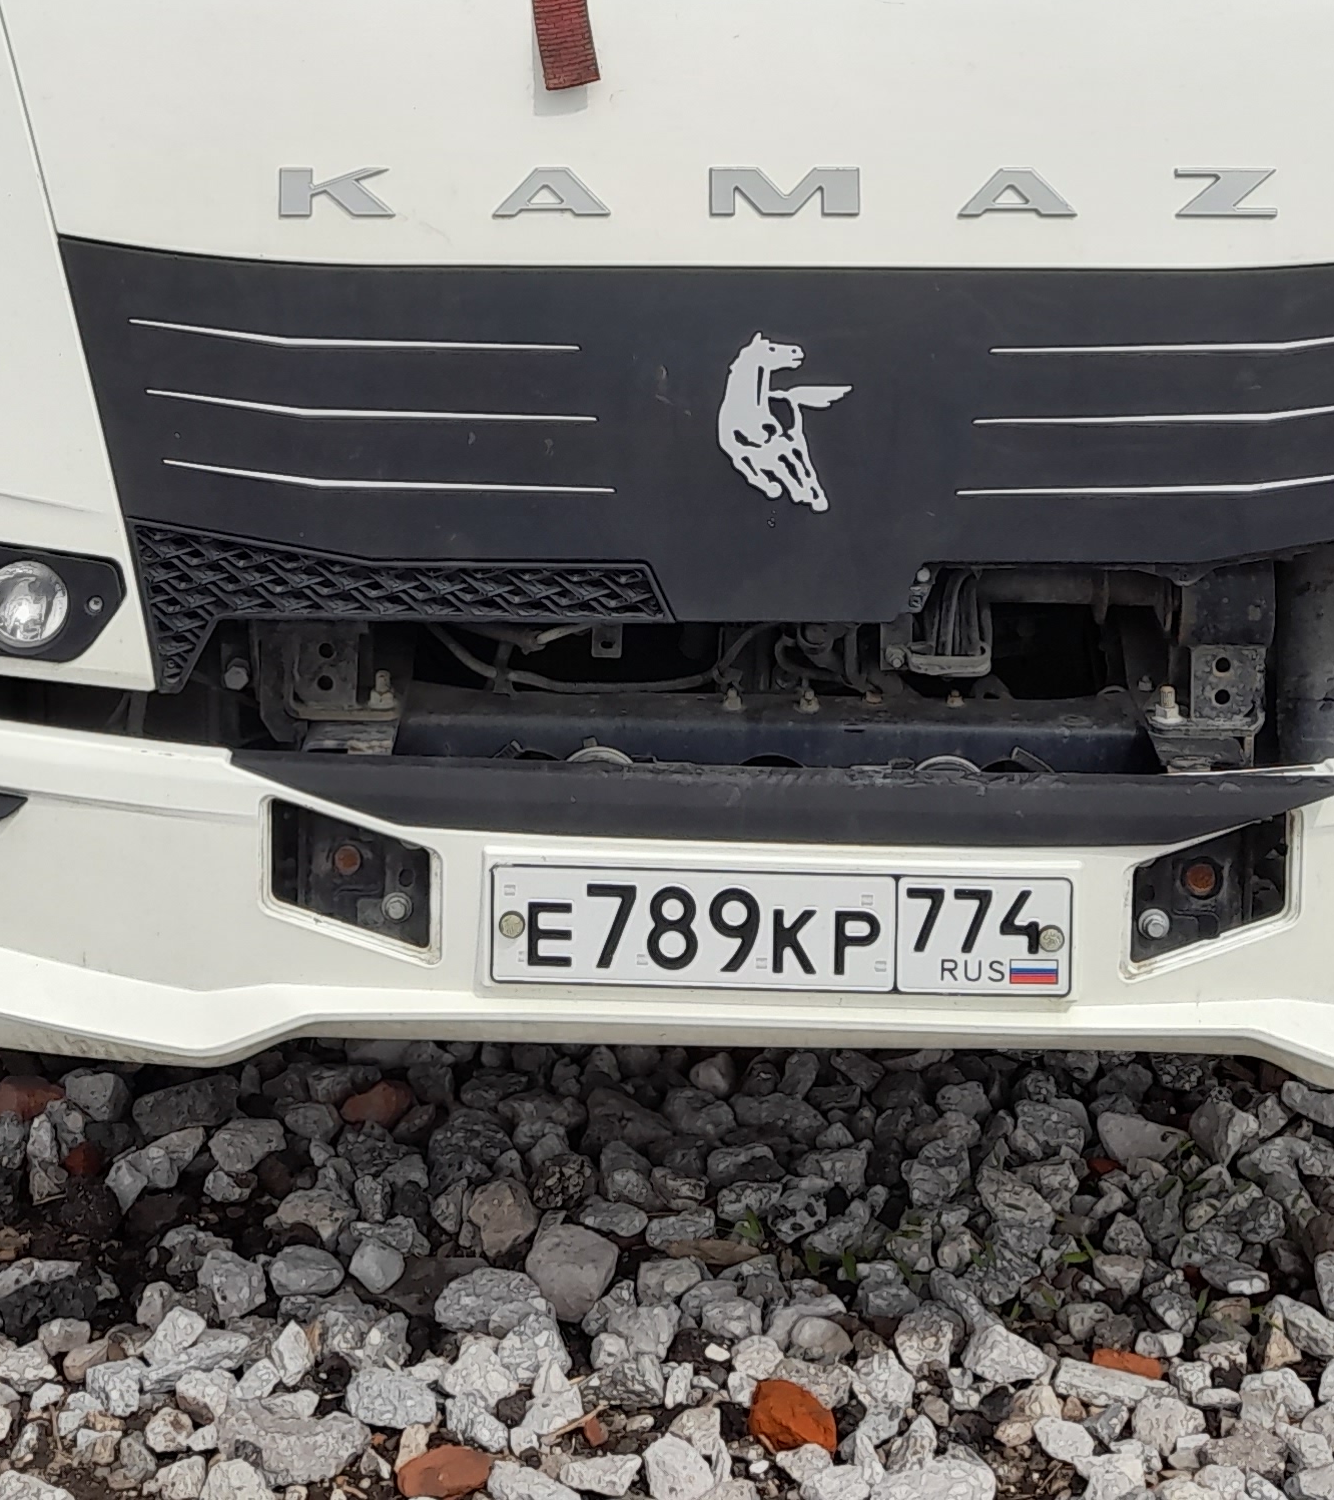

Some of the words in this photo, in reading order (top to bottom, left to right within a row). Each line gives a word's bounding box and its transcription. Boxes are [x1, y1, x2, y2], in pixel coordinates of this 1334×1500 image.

[277, 166, 1279, 221] KAMAZ
[906, 887, 1040, 955] 774
[940, 958, 1005, 982] RUS
